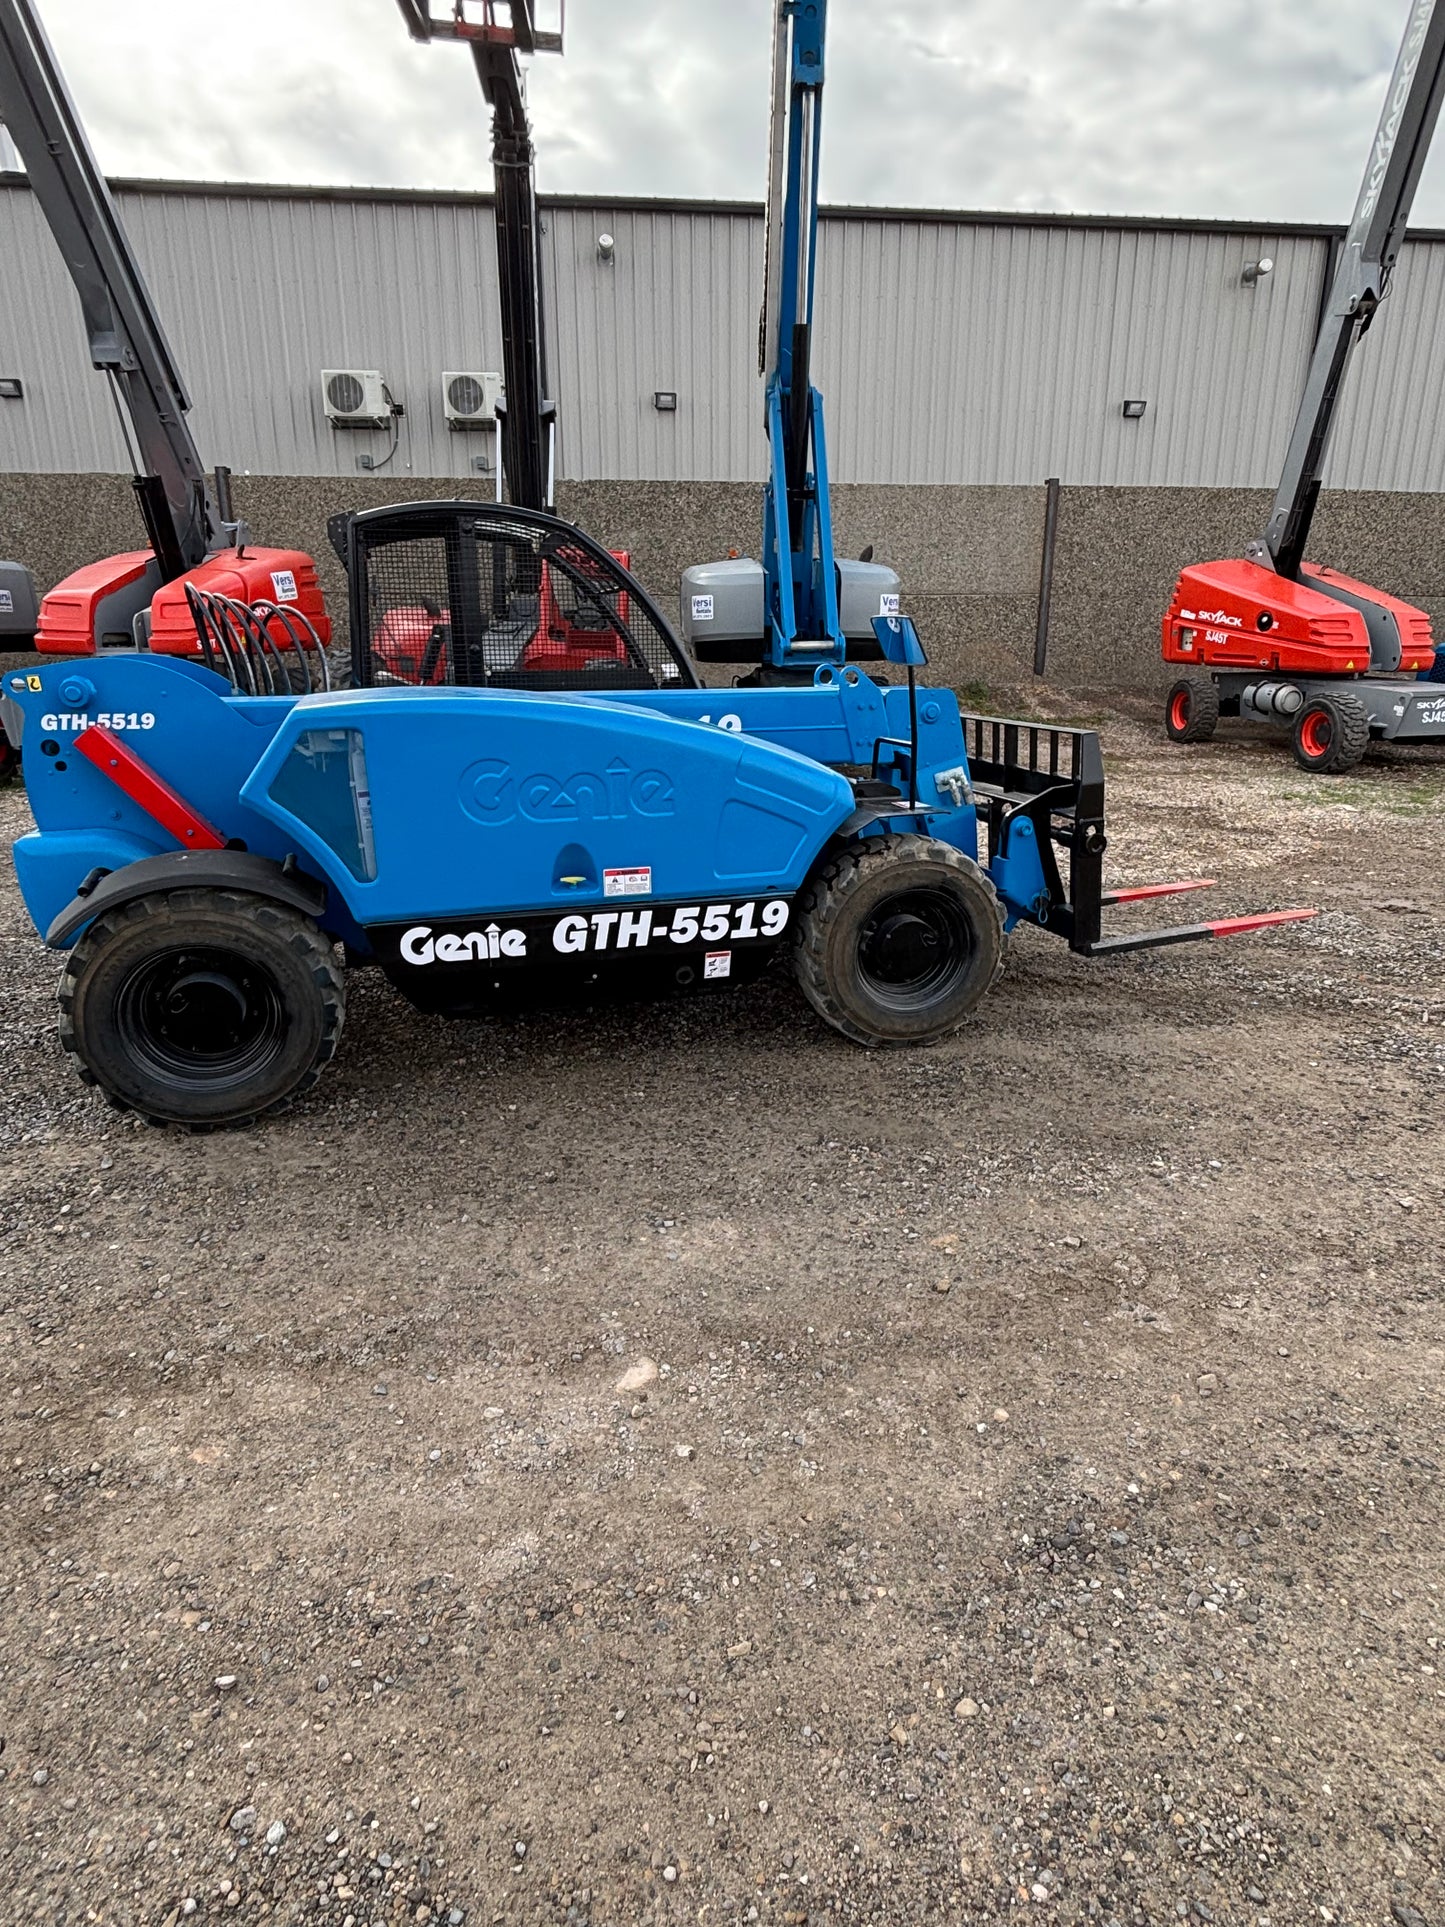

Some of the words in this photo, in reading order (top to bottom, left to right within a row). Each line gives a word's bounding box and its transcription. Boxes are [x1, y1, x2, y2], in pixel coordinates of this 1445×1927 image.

[1361, 54, 1416, 219] SKYJACK
[1409, 0, 1433, 48] SJ4
[273, 573, 294, 586] Versi
[693, 597, 711, 607] Versi
[1198, 610, 1242, 627] SKYJACK
[1205, 630, 1228, 645] SJ45T
[41, 713, 155, 730] GTH-5519
[457, 756, 675, 826] Genie
[400, 922, 526, 965] Genie
[552, 900, 789, 953] GTH-5519
